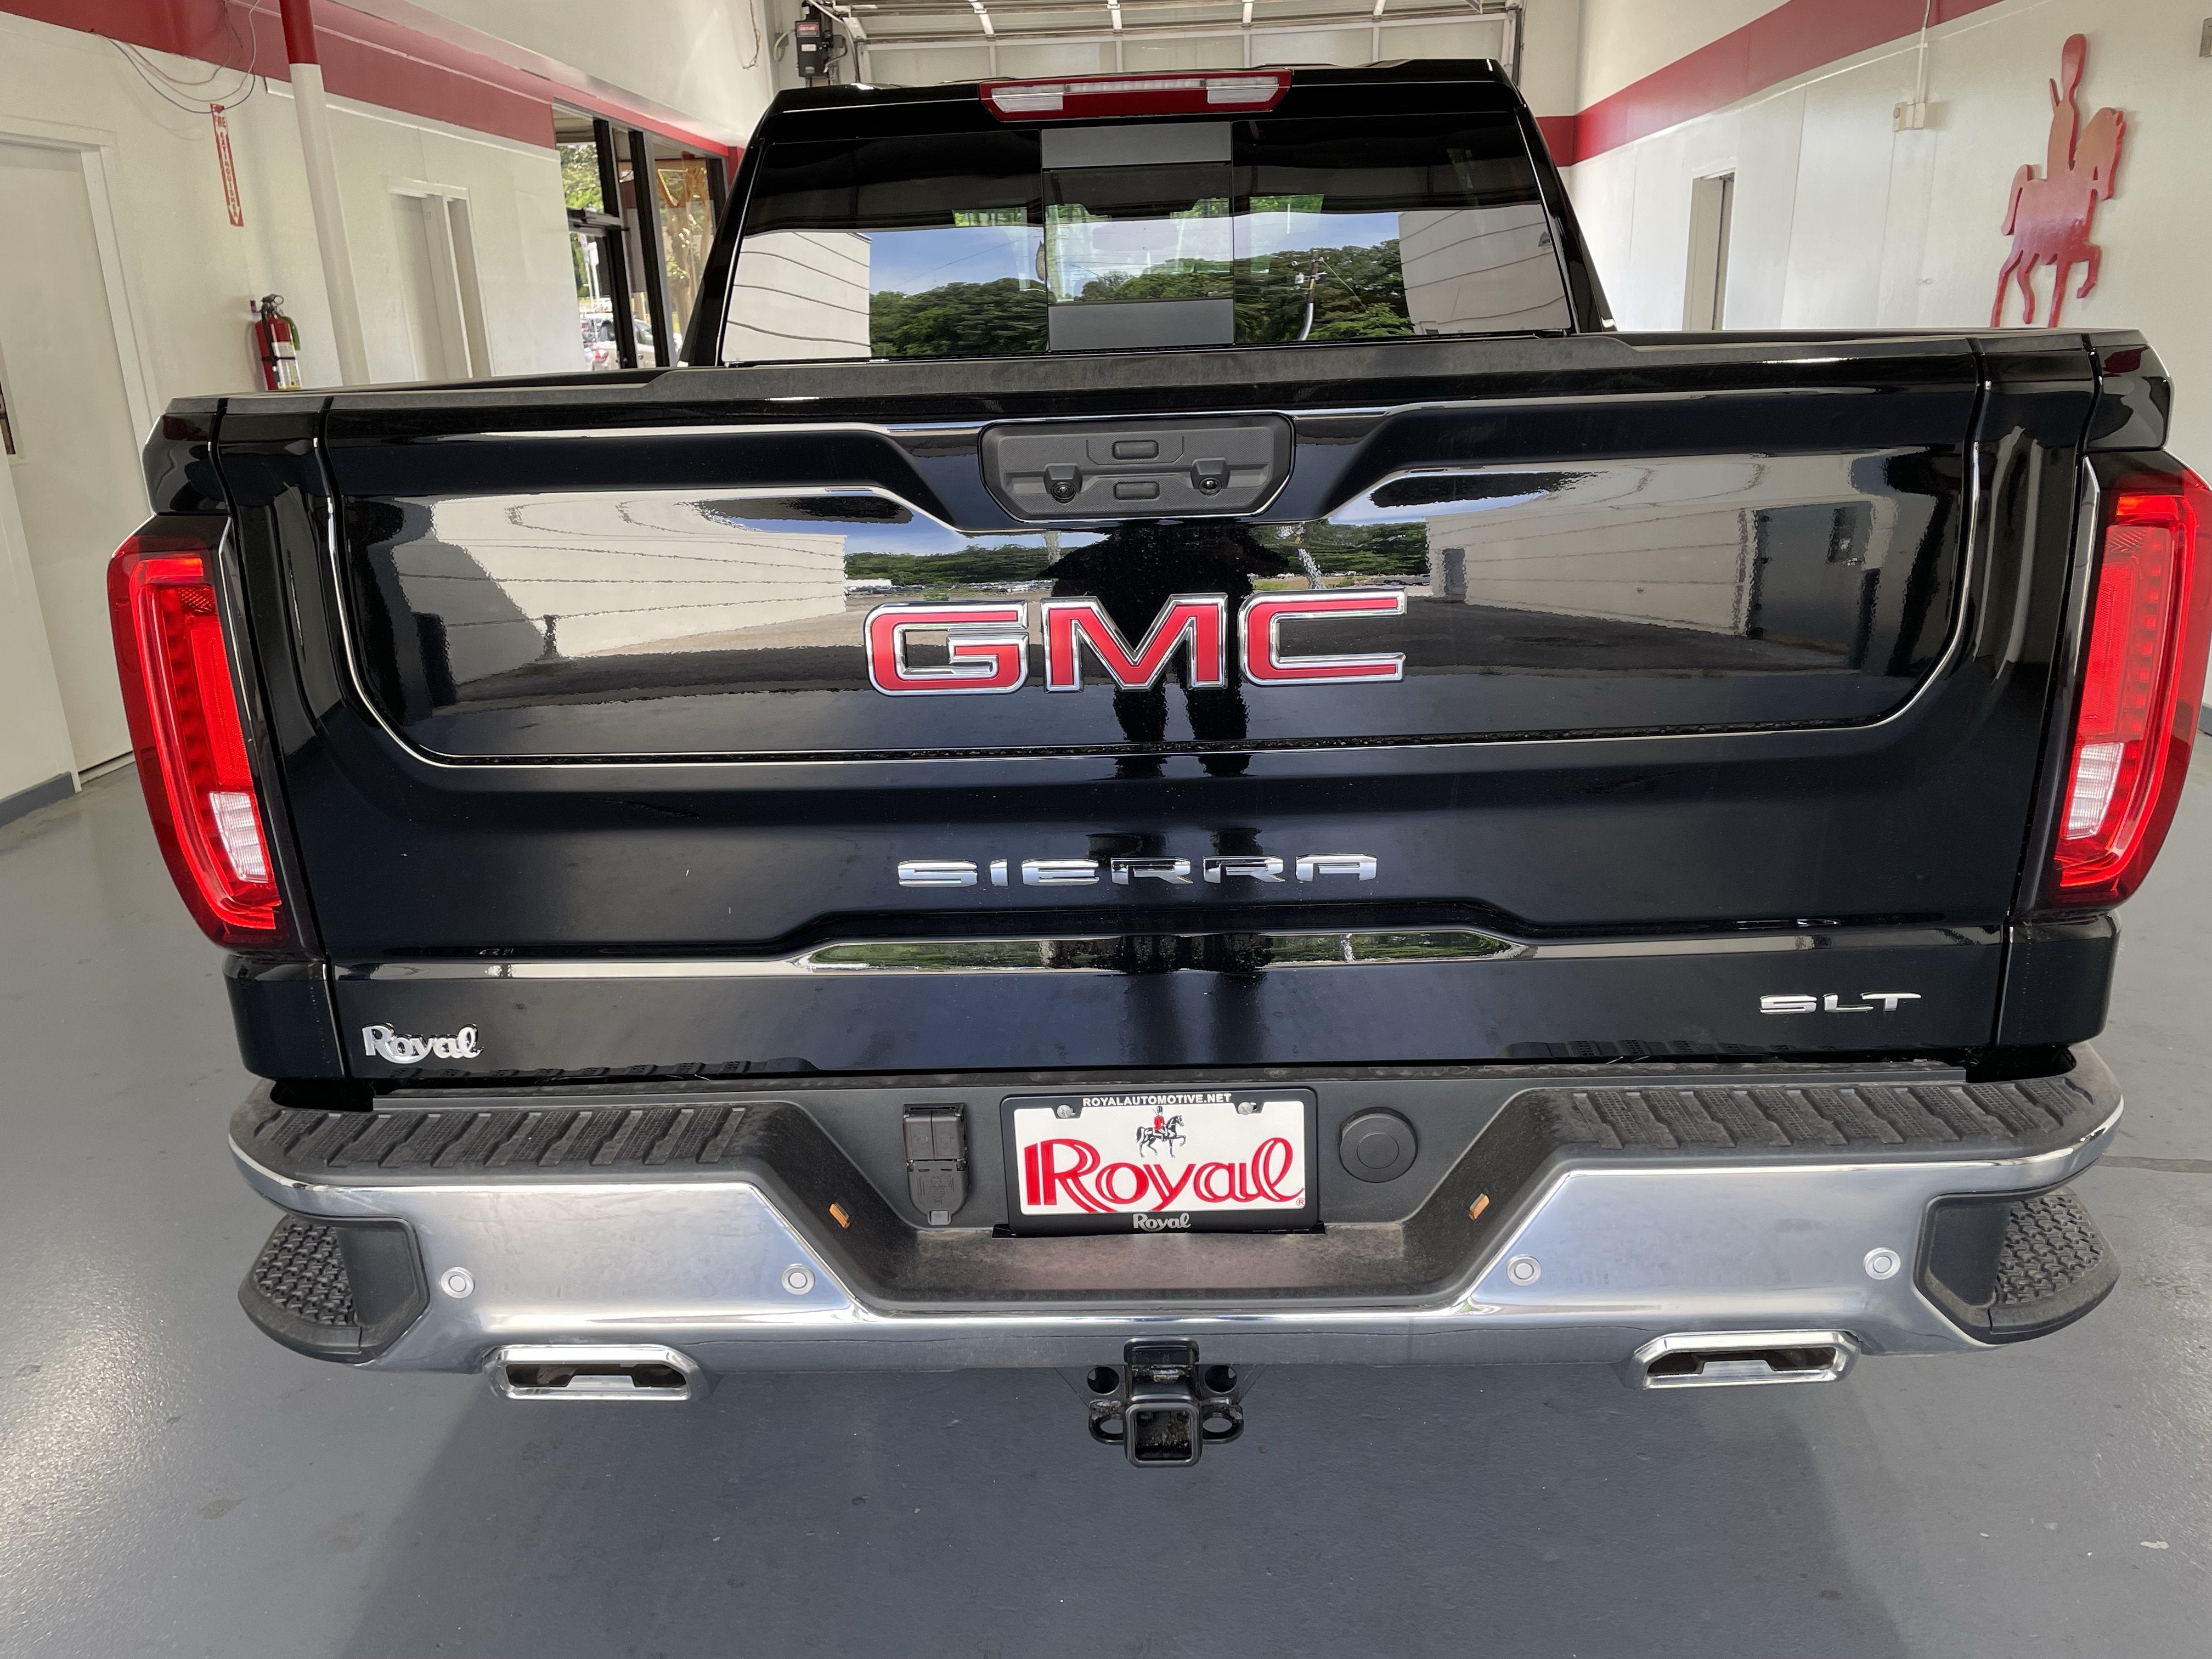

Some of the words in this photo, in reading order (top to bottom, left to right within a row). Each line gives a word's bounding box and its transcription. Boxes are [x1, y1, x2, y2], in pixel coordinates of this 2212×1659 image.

[865, 587, 1408, 697] GMC
[898, 853, 1378, 888] SIERRA
[1759, 991, 1922, 1015] SLT
[362, 1023, 485, 1064] Royal
[1082, 1093, 1232, 1107] ROYALAUTOMOTIVE.NET
[1024, 1137, 1305, 1212] Royal
[1132, 1212, 1192, 1232] Royal
